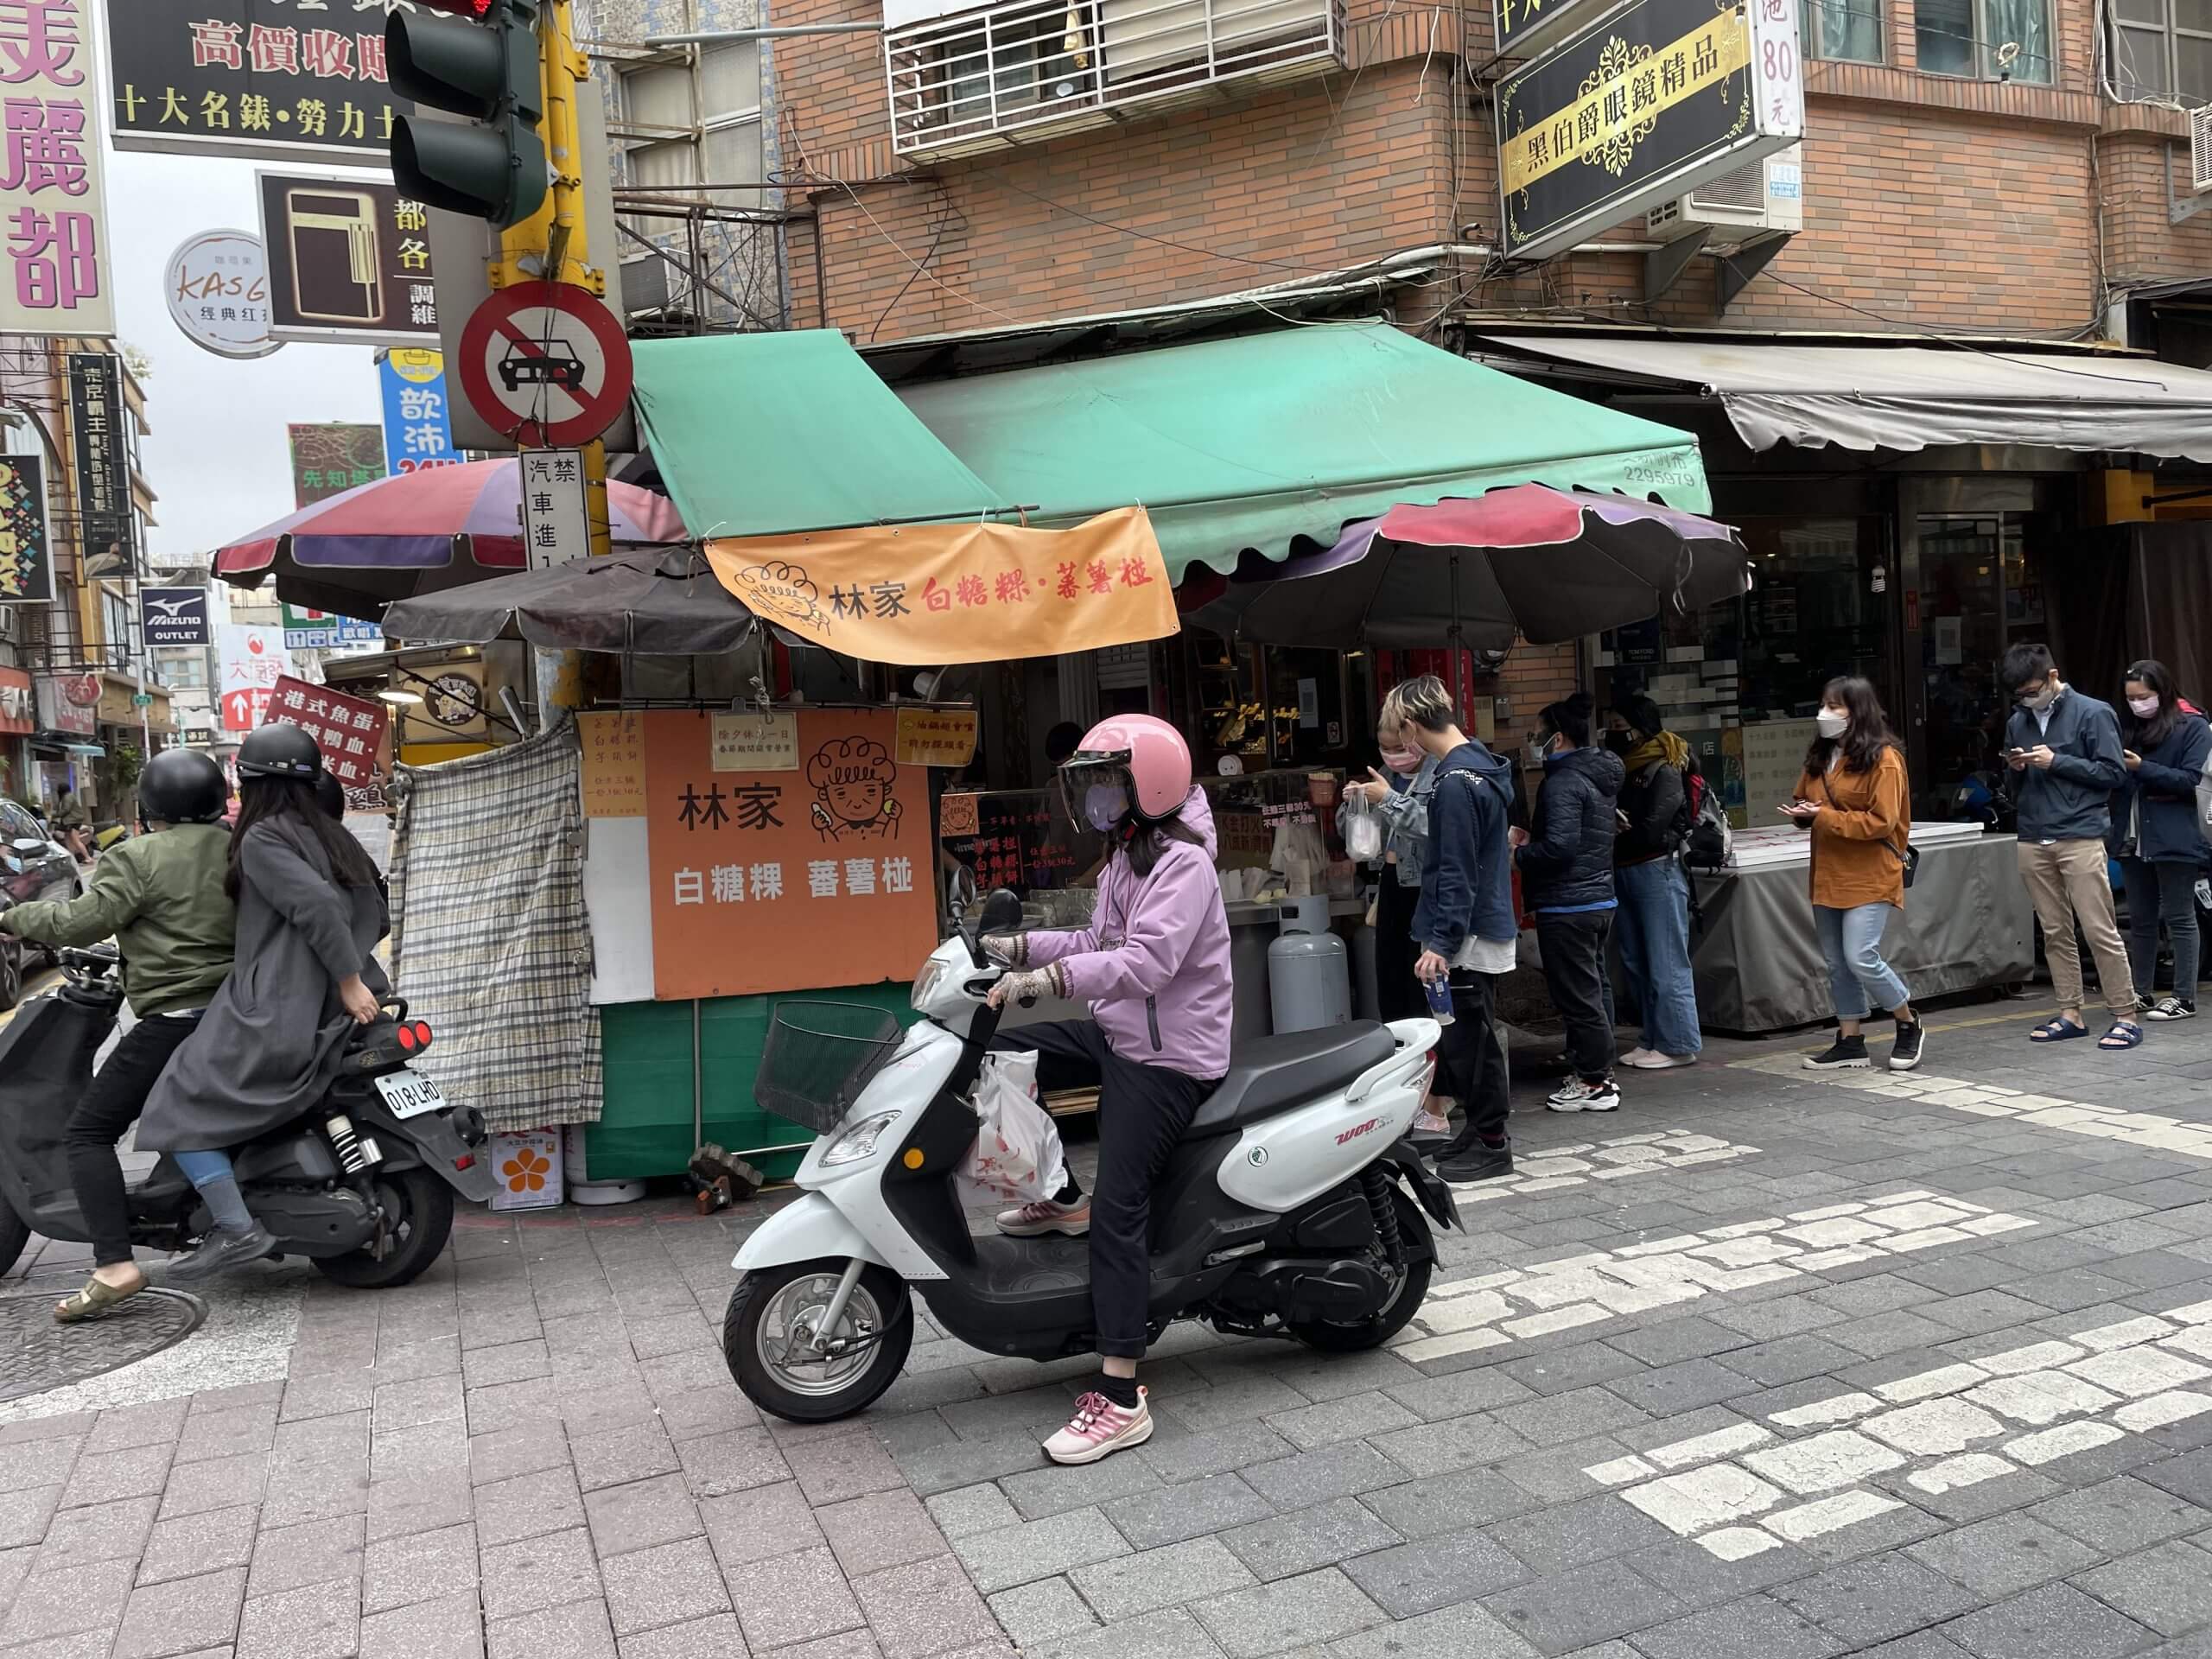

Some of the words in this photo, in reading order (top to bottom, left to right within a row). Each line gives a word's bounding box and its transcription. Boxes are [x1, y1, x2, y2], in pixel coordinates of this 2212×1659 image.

[1527, 34, 1719, 173] 黑伯爵眼鏡精品
[0, 0, 98, 309] 美麗都
[200, 307, 267, 322] 經典紅
[1624, 466, 1694, 486] 2295979
[529, 461, 558, 569] 汽車進
[827, 580, 911, 620] 林家
[283, 689, 374, 732] 港式魚蛋
[677, 781, 785, 831] 林家
[673, 862, 784, 906] 白糖粿
[386, 1080, 440, 1111] 018-LHD
